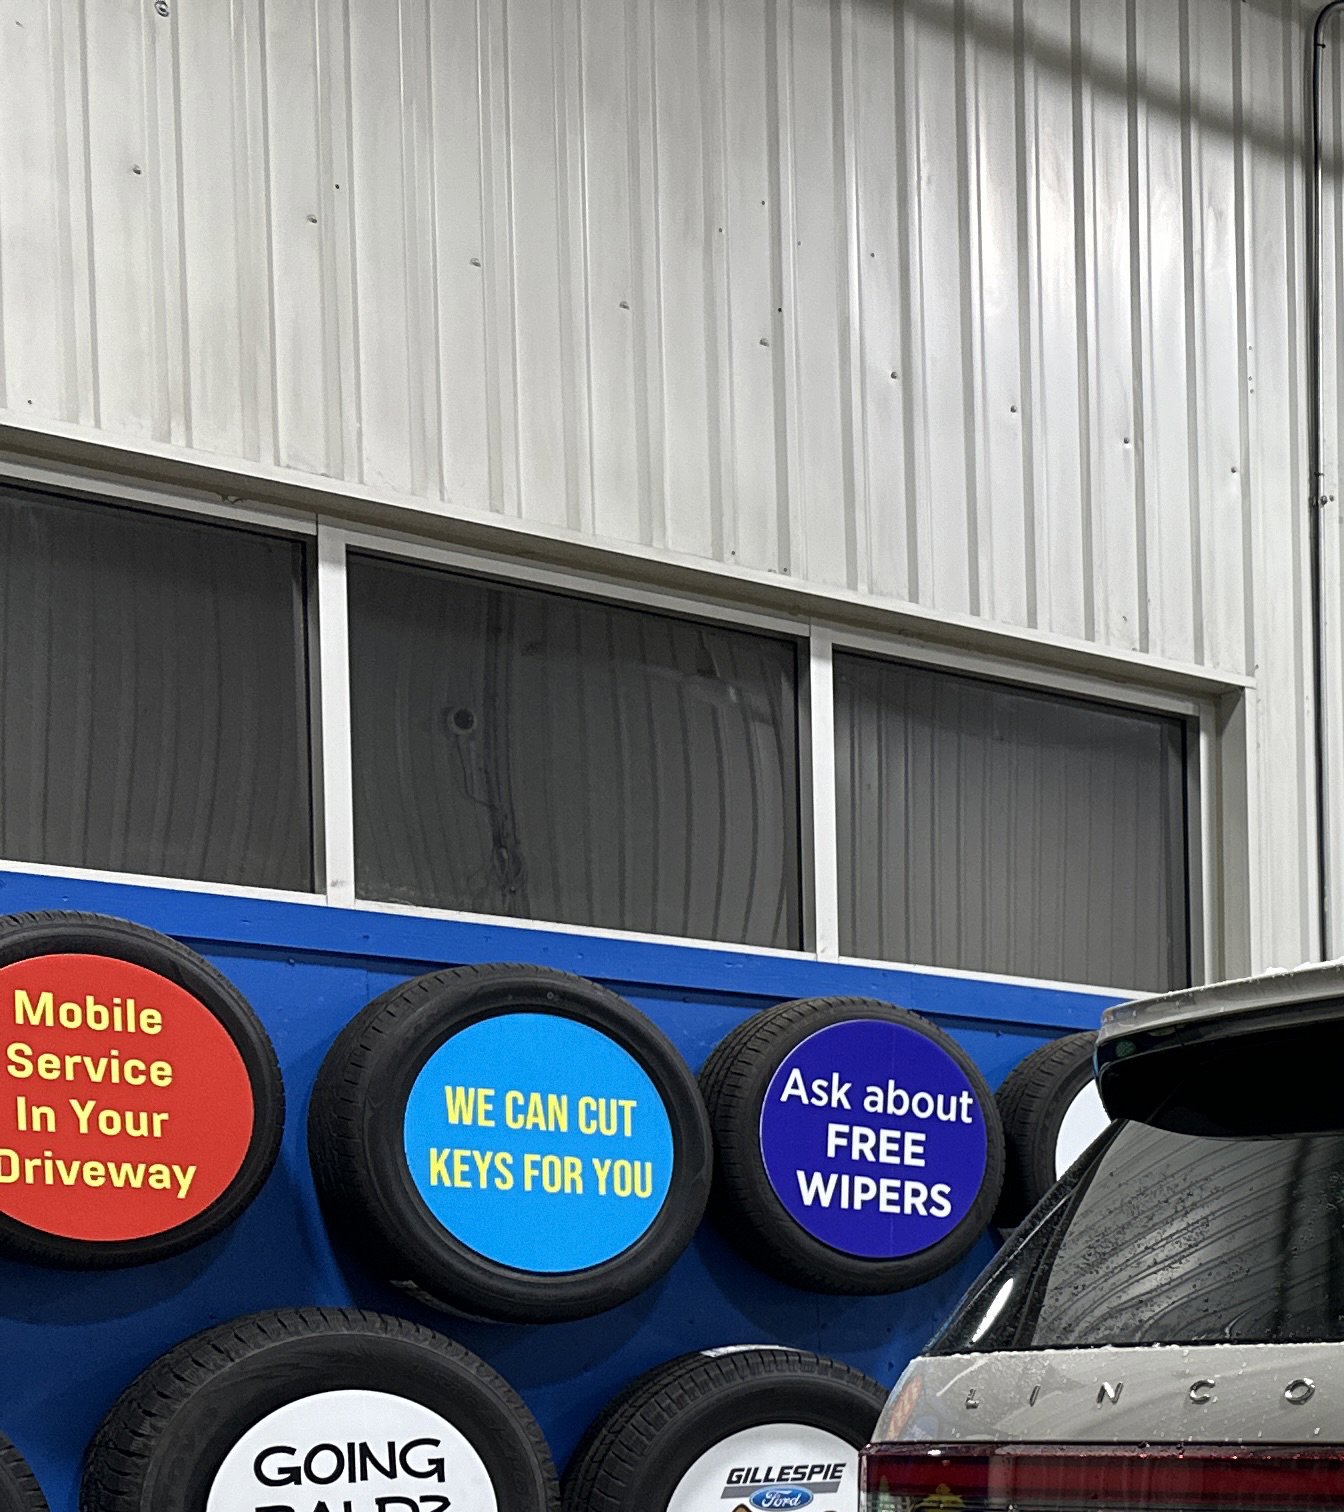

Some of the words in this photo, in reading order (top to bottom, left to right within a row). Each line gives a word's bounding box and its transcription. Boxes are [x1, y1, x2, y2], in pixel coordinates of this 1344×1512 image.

[14, 989, 164, 1035] Mobile
[6, 1042, 174, 1087] Service
[17, 1096, 58, 1134] In
[71, 1099, 170, 1138] Your
[444, 1084, 497, 1128] WE
[504, 1090, 569, 1134] CAN
[577, 1096, 639, 1138] CUT
[779, 1067, 853, 1112] Ask
[862, 1079, 974, 1125] about
[826, 1123, 927, 1168] FREE
[0, 1147, 197, 1200] Driveway
[429, 1146, 514, 1192] KEYS
[523, 1153, 584, 1196] FOR
[593, 1158, 654, 1200] YOU
[796, 1169, 952, 1218] WIPERS
[253, 1437, 447, 1488] GOING
[725, 1462, 847, 1485] GILLESPIE
[761, 1489, 803, 1510] Ford
